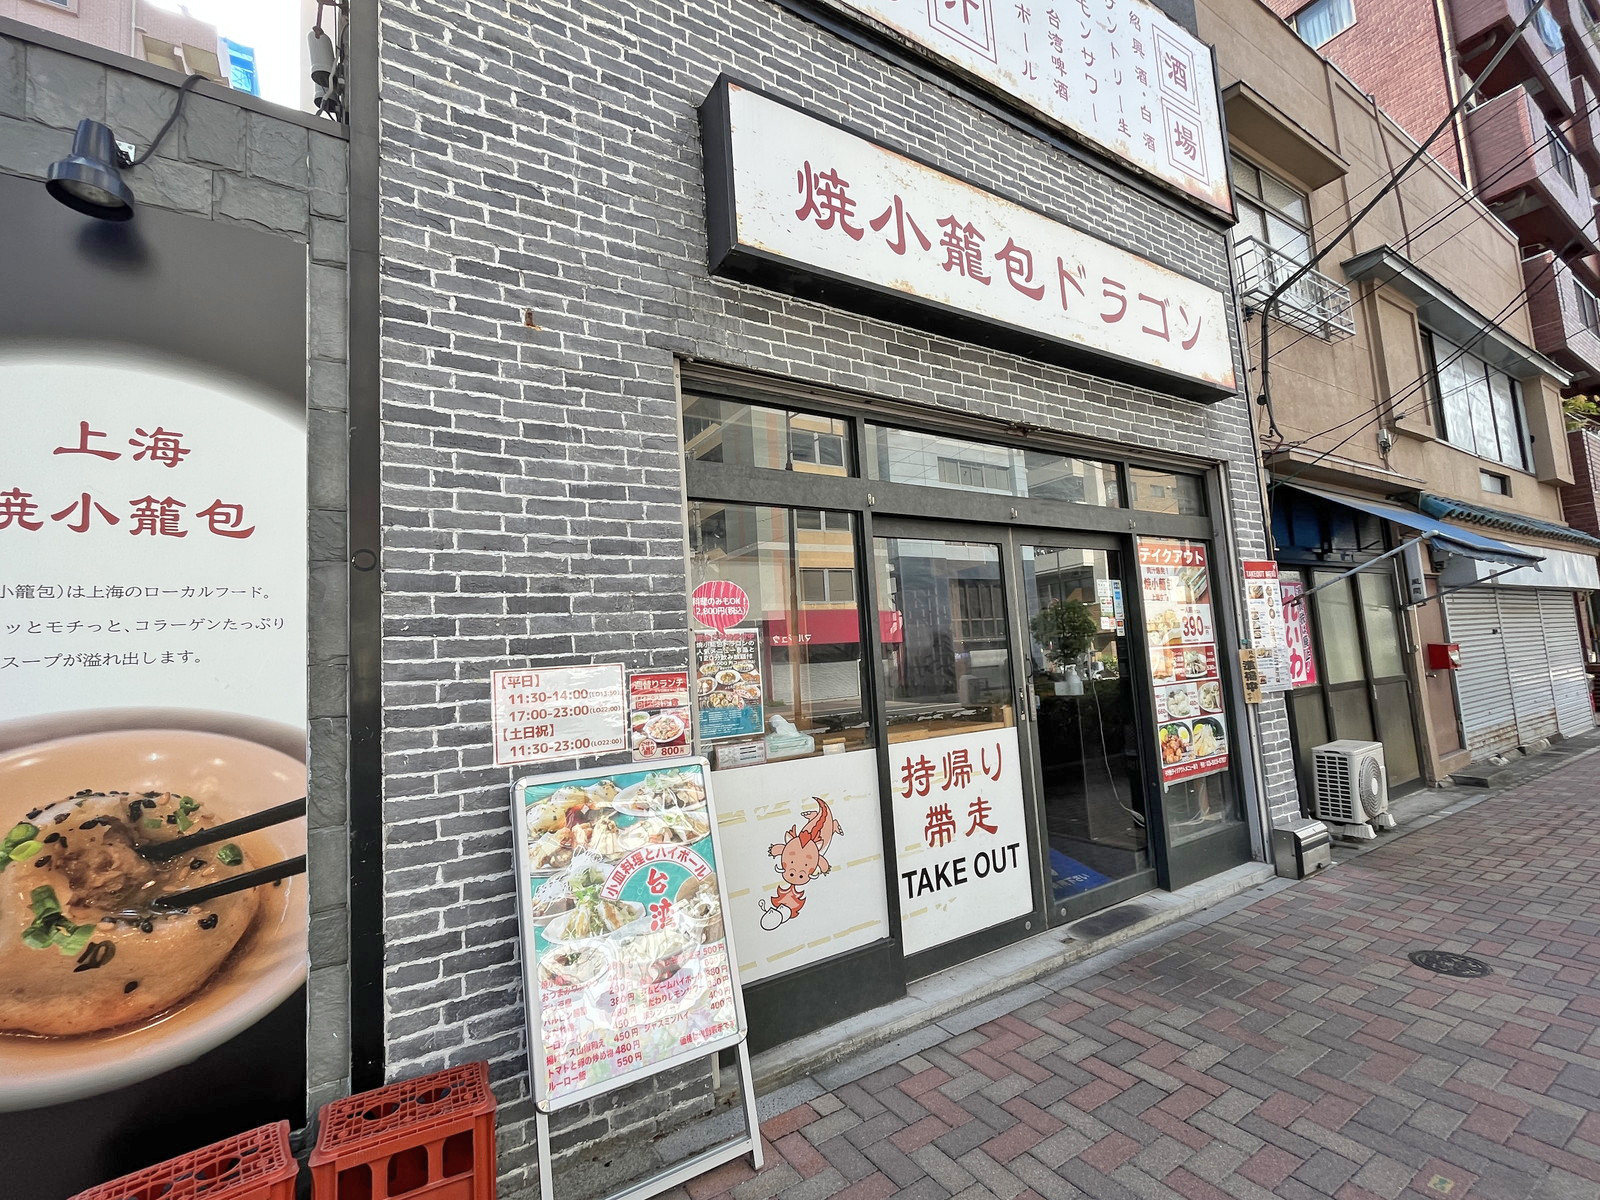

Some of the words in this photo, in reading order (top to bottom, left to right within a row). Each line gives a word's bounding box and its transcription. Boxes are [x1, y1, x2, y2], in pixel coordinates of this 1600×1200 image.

[1046, 8, 1069, 102] 台湾啤酒
[1164, 51, 1197, 161] 酒場
[795, 160, 1202, 351] 焼小籠包ドラゴン
[52, 420, 192, 469] 上海
[1139, 546, 1204, 565] テイクアウト
[1181, 615, 1204, 637] 390
[1, 649, 202, 670] スープが溢れ出します。
[501, 674, 540, 690] 【平日】
[508, 688, 589, 705] 11:30-14:00
[509, 705, 589, 722] 17:00-23:00
[503, 723, 555, 742] 【土日祝】
[510, 738, 591, 757] 11:30-23:00
[661, 746, 685, 756] 800円
[900, 742, 1003, 799] 持帰り
[606, 846, 707, 897] 小皿料理とハイボール
[901, 856, 967, 900] TAKE
[973, 842, 1021, 879] OUT
[613, 1027, 639, 1043] 450円
[615, 1039, 641, 1055] 480円
[616, 1051, 643, 1068] 550円
